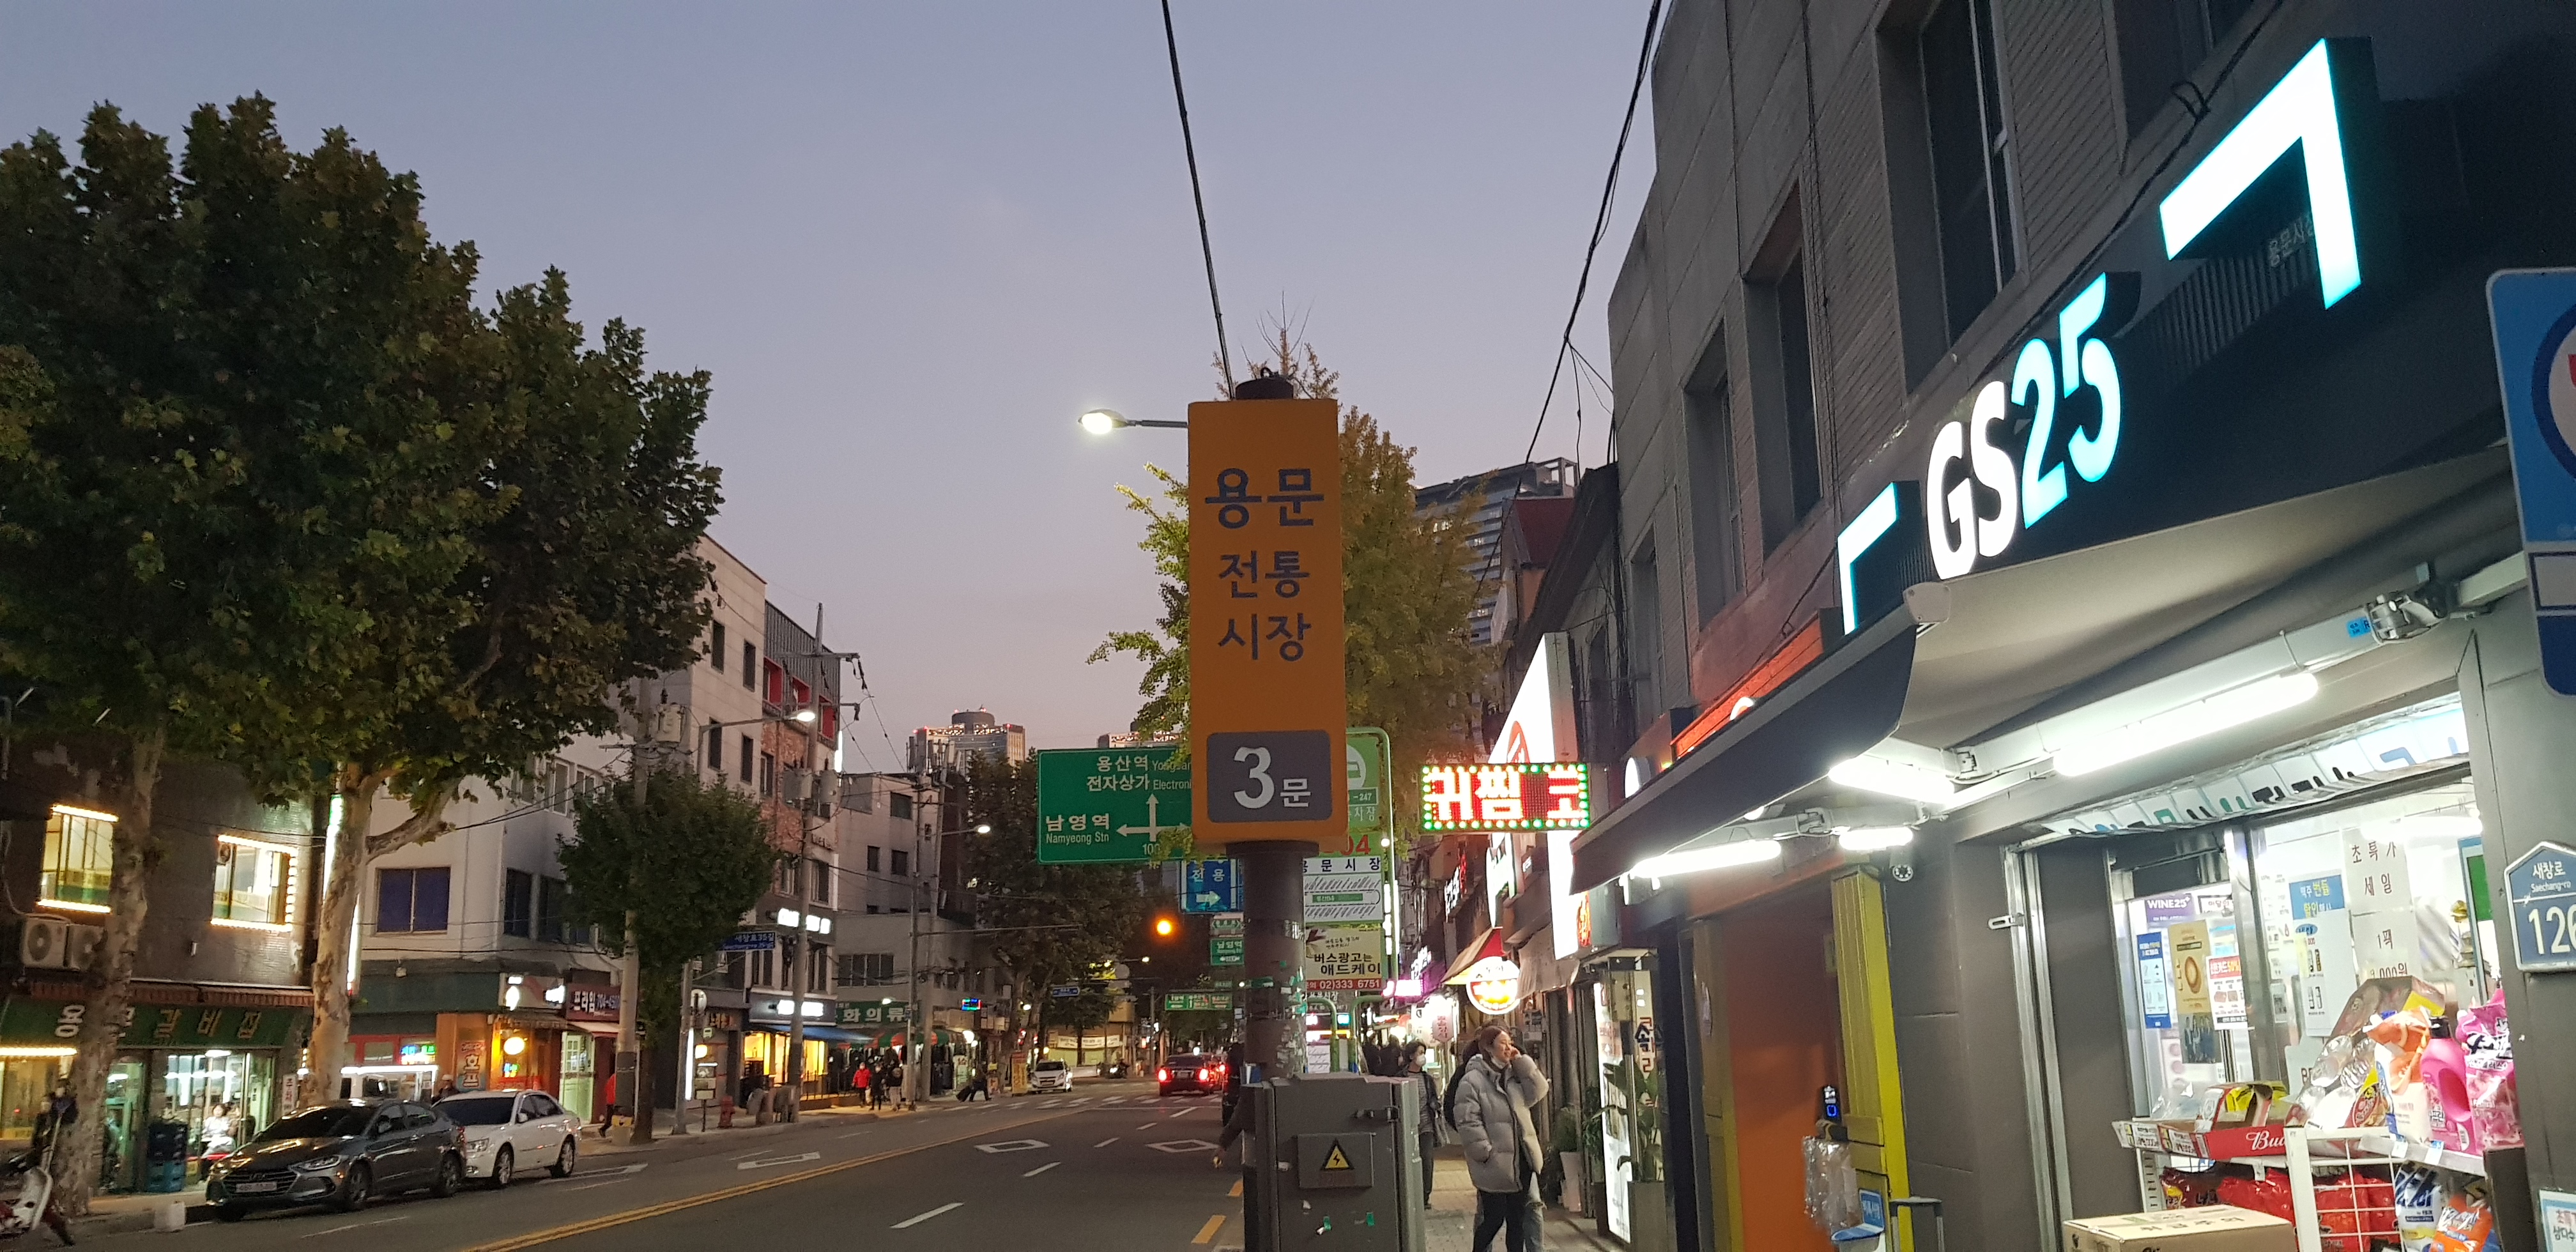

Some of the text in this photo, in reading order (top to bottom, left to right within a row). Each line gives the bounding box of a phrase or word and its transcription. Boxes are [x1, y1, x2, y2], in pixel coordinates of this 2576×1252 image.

[1926, 271, 2122, 580] GS25
[1204, 467, 1325, 529] 용문
[1218, 550, 1310, 599] 전통
[1217, 613, 1312, 662] 시장
[1096, 754, 1149, 772] 용산역
[1086, 773, 1150, 792] 전자상가
[1045, 813, 1110, 832] 남영역
[1349, 805, 1376, 822] 시장
[1046, 831, 1110, 846] Namyeong Stn
[1192, 868, 1225, 883] 전용
[2532, 860, 2566, 880] 새창로
[2364, 872, 2393, 896] 세일
[2531, 880, 2572, 894] Saechang-ro
[1314, 952, 1373, 964] 버스광고는
[1320, 963, 1381, 976] 애드케이
[1319, 979, 1353, 990] 02)333
[1357, 979, 1380, 989] 6751
[835, 1007, 906, 1023] 화의류
